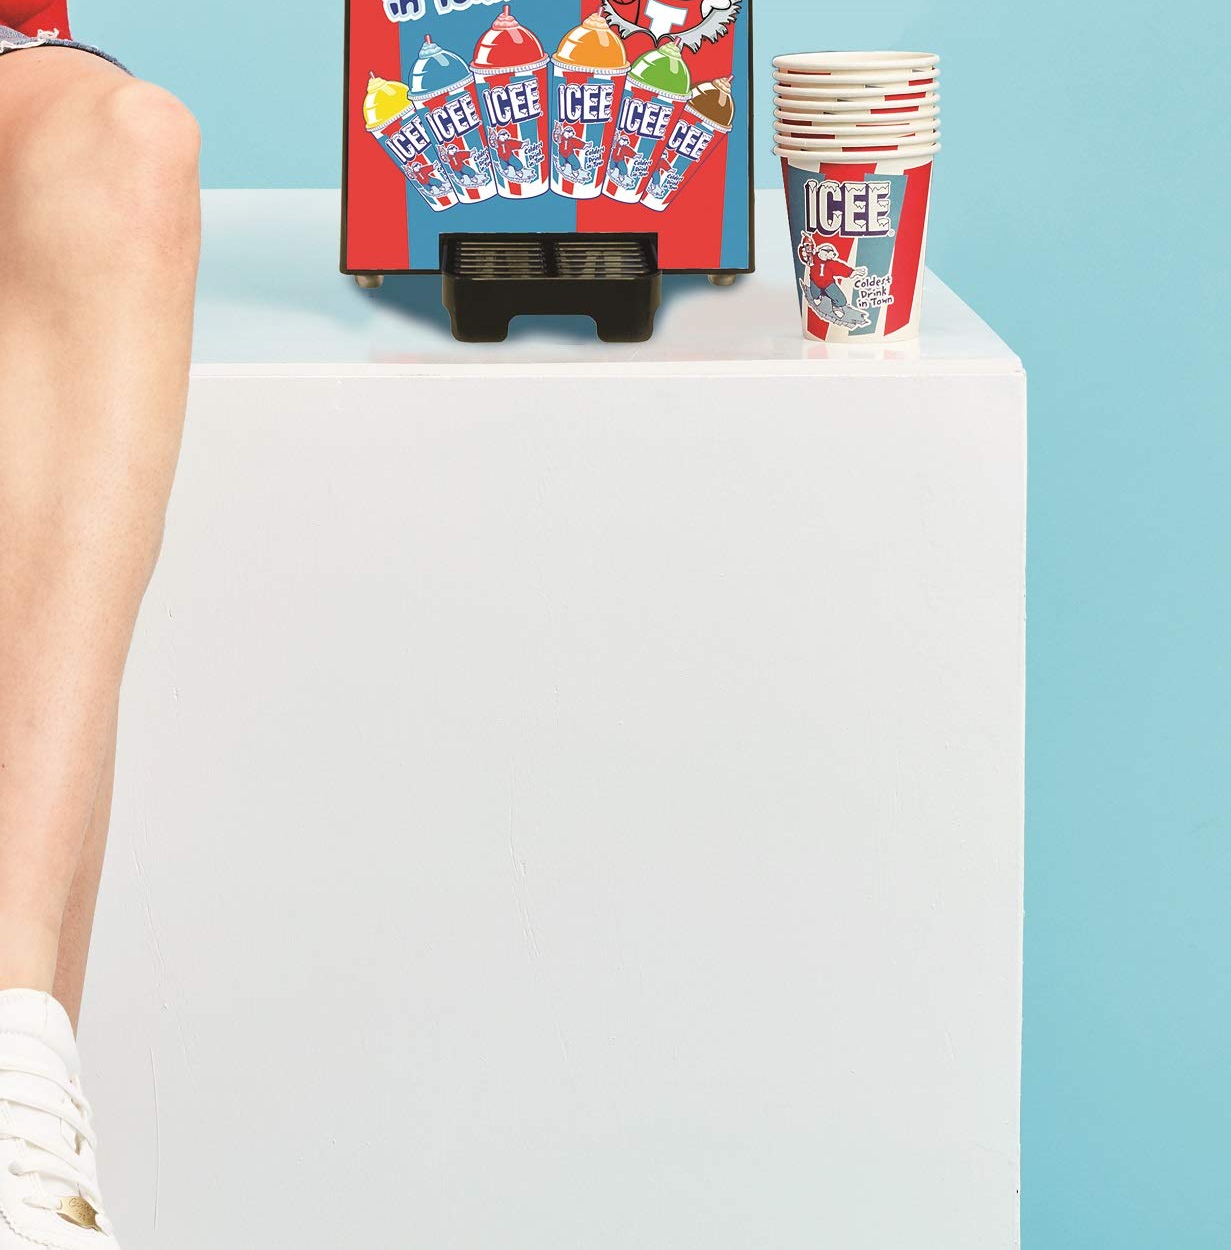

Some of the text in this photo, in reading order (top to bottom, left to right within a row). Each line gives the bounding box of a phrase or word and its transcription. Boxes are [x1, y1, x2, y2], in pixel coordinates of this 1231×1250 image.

[425, 92, 481, 145] ICEE
[483, 78, 542, 128] ICEE
[558, 83, 613, 124] ICEE
[618, 97, 674, 140] ICEE
[666, 119, 714, 161] CEE
[805, 181, 890, 236] ICEE
[854, 276, 891, 288] Coldest
[858, 297, 893, 307] in Town
[860, 286, 887, 299] Drink
